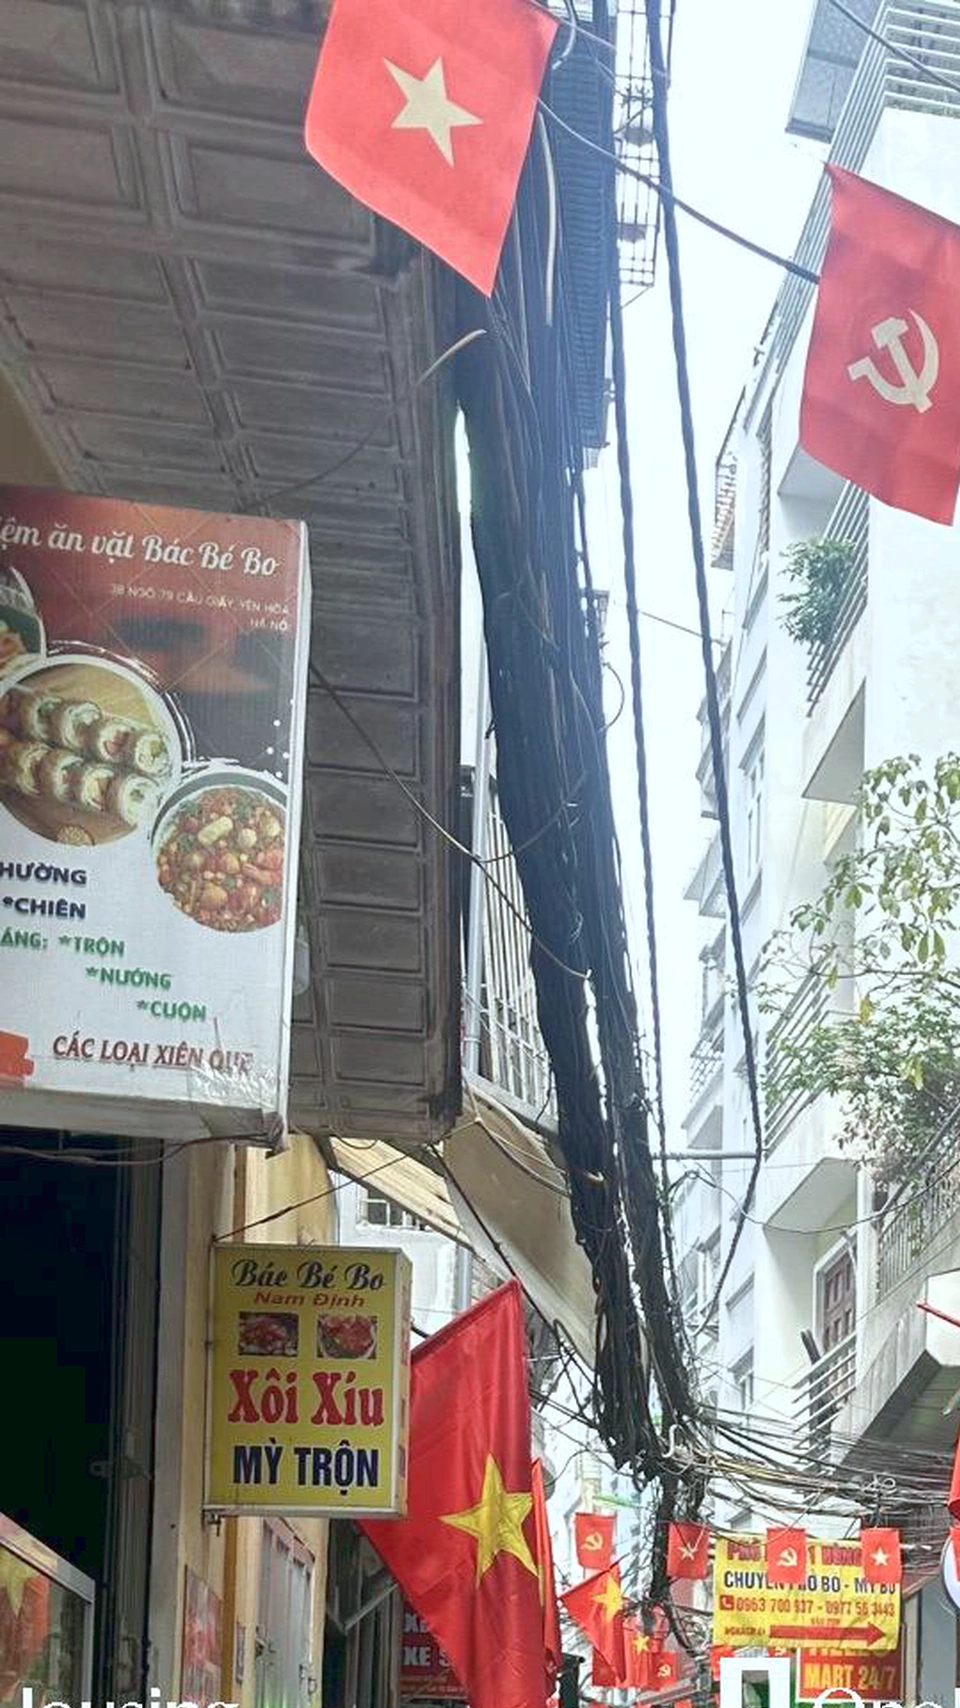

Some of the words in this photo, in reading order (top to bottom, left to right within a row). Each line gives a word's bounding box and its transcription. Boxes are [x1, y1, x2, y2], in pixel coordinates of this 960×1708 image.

[48, 521, 85, 552] ăn
[91, 529, 135, 564] vặt
[142, 534, 194, 565] Bác
[199, 541, 235, 571] Bé
[241, 547, 279, 576] Bo
[52, 1031, 96, 1059] CÁC
[100, 1041, 150, 1072] LOẠI
[153, 1041, 205, 1068] XIÊN
[296, 1260, 338, 1289] Bé
[344, 1262, 385, 1291] Bo
[255, 1291, 304, 1307] Nam
[312, 1291, 366, 1309] Định
[227, 1367, 300, 1425] Xôi
[310, 1370, 386, 1427] Xíu
[293, 1438, 379, 1496] TRỘN
[804, 1663, 852, 1691] MART
